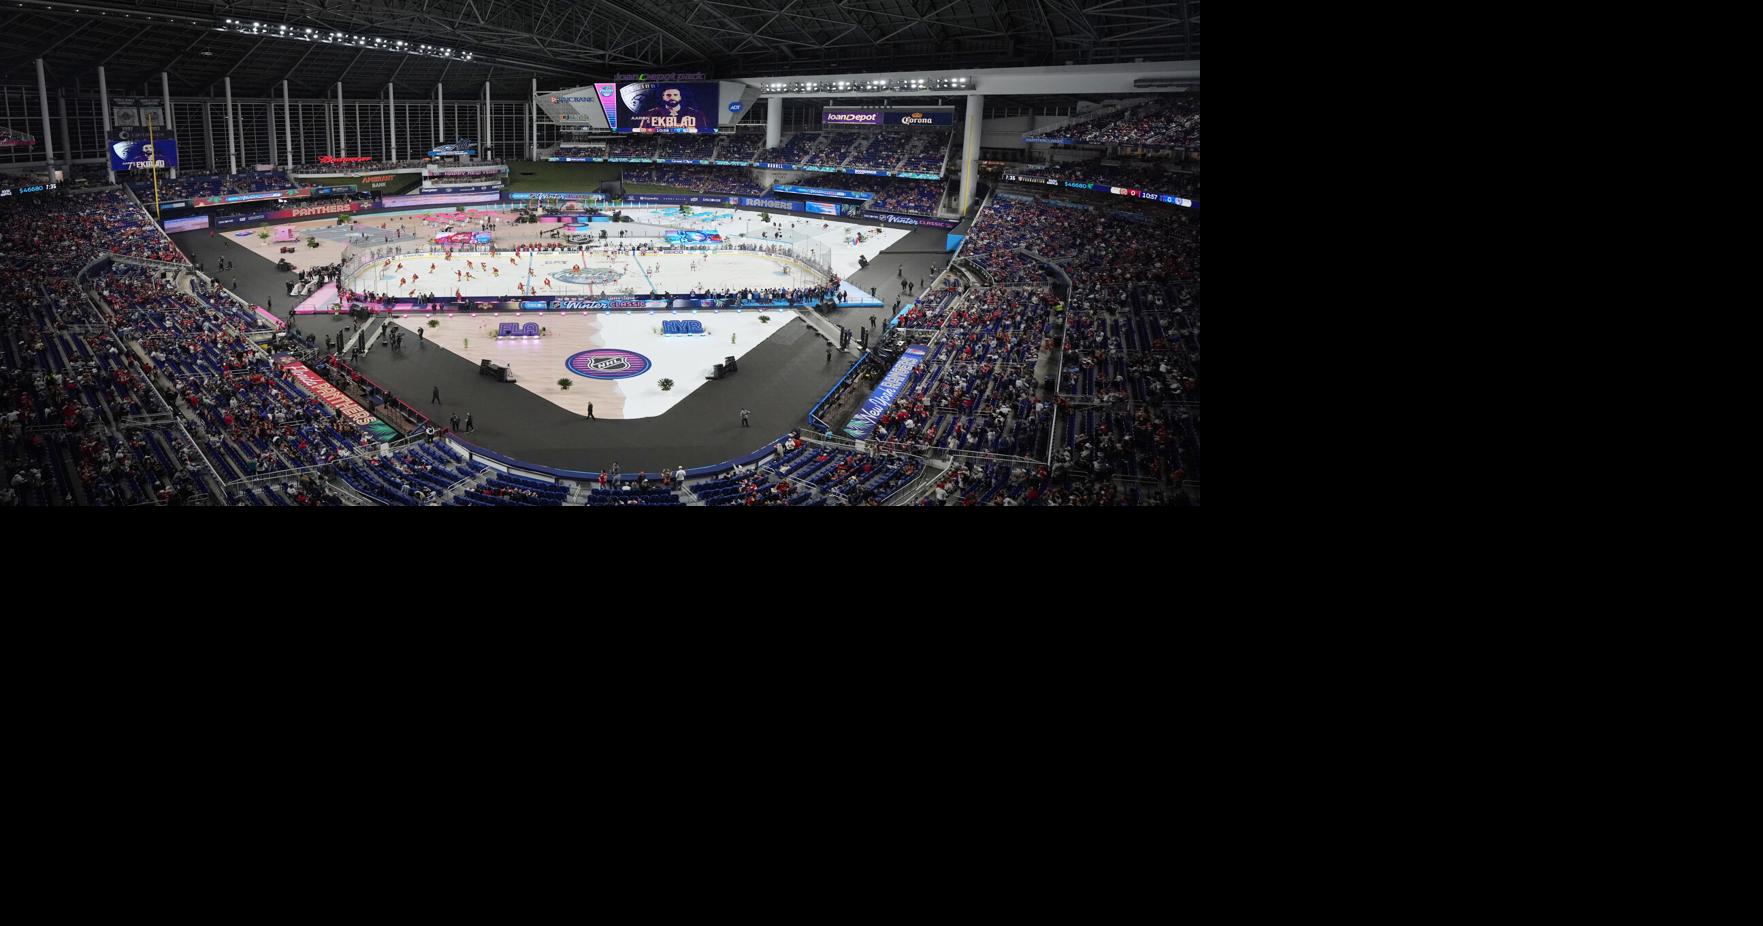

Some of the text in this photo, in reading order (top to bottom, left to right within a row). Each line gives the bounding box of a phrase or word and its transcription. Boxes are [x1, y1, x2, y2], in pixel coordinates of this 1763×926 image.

[651, 115, 696, 128] EKBLAD
[828, 113, 877, 122] loanDepot
[901, 115, 933, 125] Corona
[292, 204, 351, 217] PANTHERS
[746, 198, 793, 210] RANGERS
[887, 214, 919, 226] Winter
[919, 219, 945, 227] CLASSIC
[562, 300, 609, 310] Winter
[609, 300, 647, 309] CLASSIC
[498, 322, 540, 336] FLA
[662, 320, 705, 335] NYR
[597, 357, 622, 370] NHL
[862, 356, 918, 425] New York RANGERS
[313, 382, 377, 426] PANTHERS
